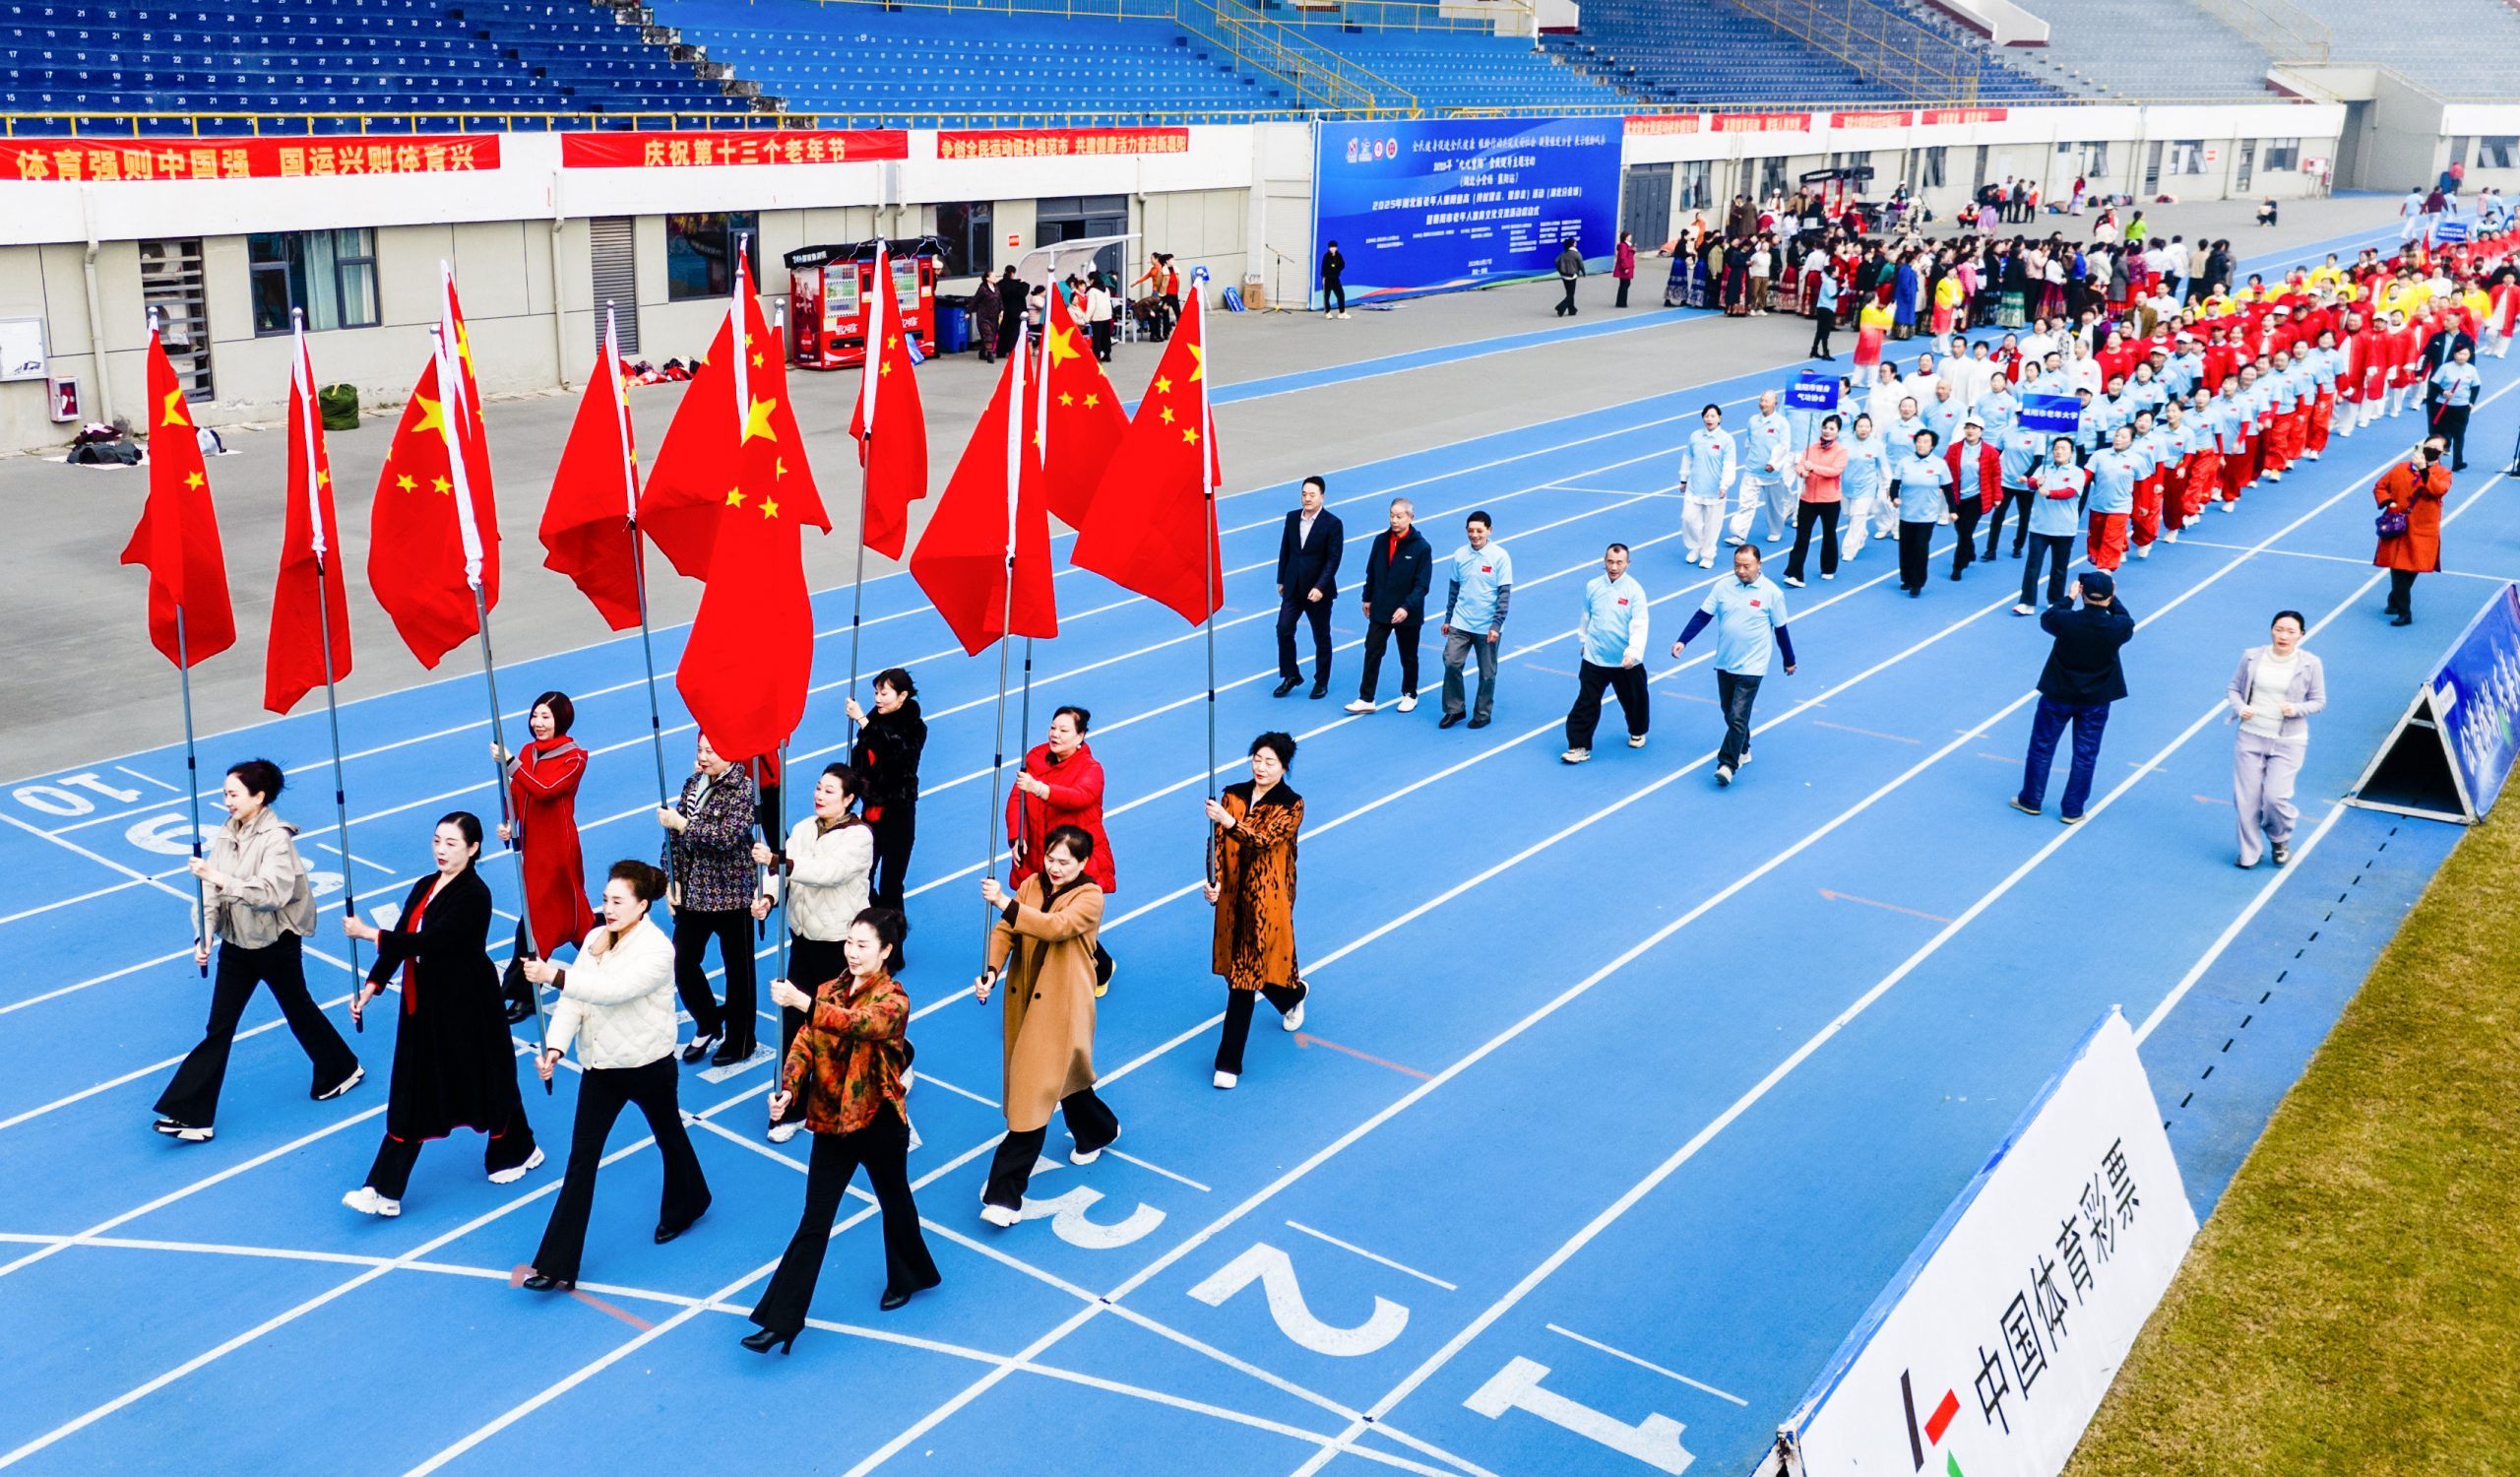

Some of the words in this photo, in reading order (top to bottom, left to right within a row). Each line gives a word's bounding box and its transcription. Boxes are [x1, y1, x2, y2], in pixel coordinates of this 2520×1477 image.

[16, 149, 251, 181] 体育强则中国强
[279, 144, 474, 177] 国运兴则体育兴
[644, 138, 846, 166] 庆祝第十三个老年节
[12, 771, 143, 817] 10
[1187, 1241, 1410, 1358] 2
[1974, 1136, 2140, 1436] 中国体育彩票
[1462, 1355, 1697, 1475] 1
